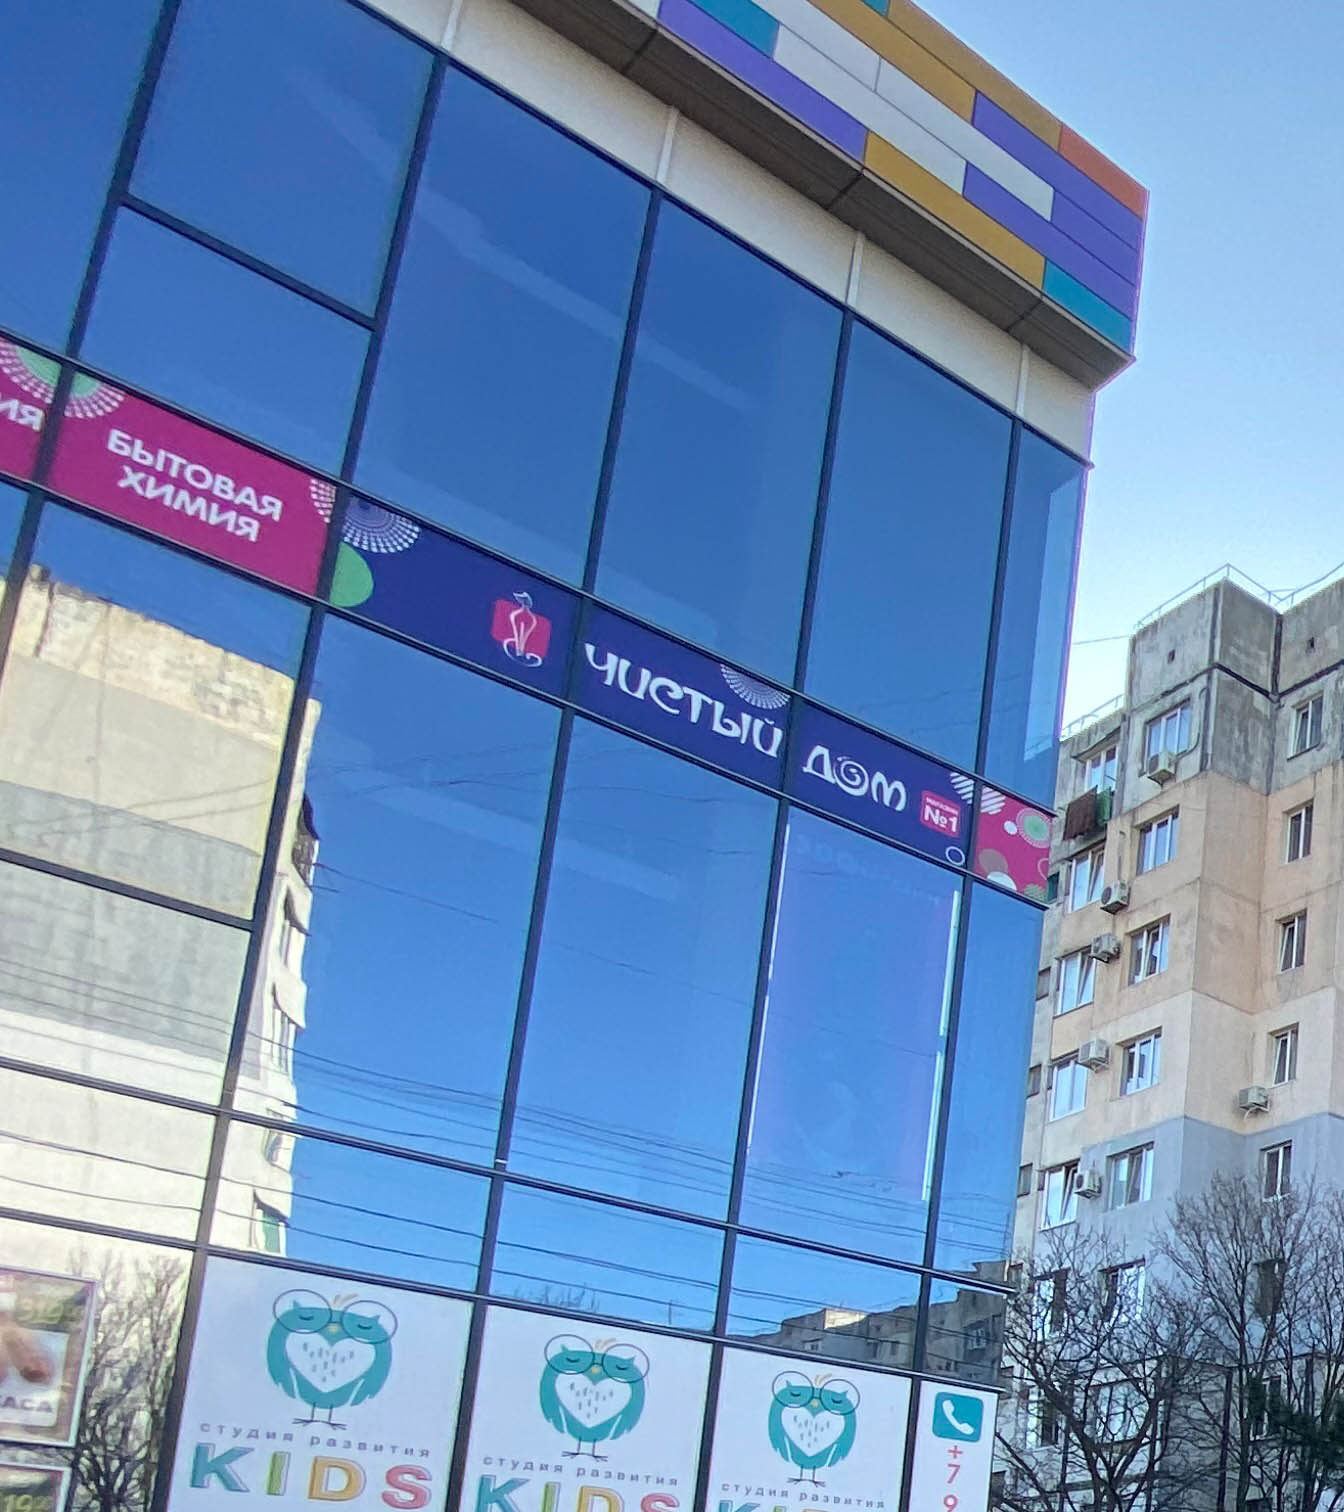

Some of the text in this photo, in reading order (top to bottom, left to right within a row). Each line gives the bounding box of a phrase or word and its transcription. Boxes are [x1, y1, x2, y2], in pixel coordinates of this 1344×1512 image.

[107, 427, 284, 524] БЫТОВАЯ
[117, 464, 261, 543] ХИМИЯ
[924, 804, 958, 833] №1
[200, 1422, 431, 1458] студия развития
[190, 1442, 433, 1510] KIDS
[483, 1456, 679, 1487] студия развития
[721, 1483, 885, 1509] студия развития
